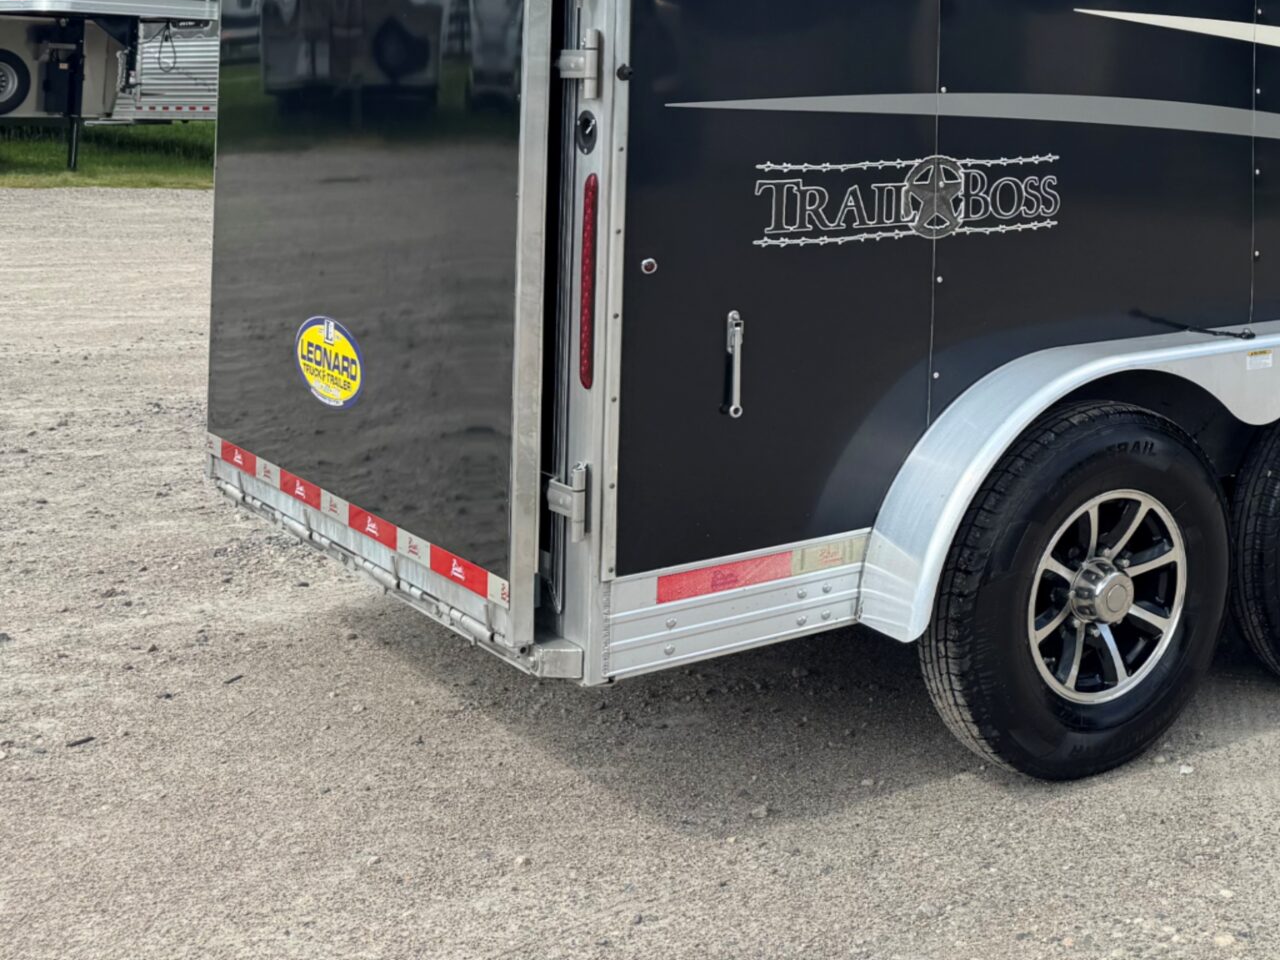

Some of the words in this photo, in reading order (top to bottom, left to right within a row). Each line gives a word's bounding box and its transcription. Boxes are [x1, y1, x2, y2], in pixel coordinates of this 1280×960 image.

[755, 179, 918, 234] TRAIL
[958, 169, 1061, 221] BOSS
[300, 338, 357, 382] LEONARD
